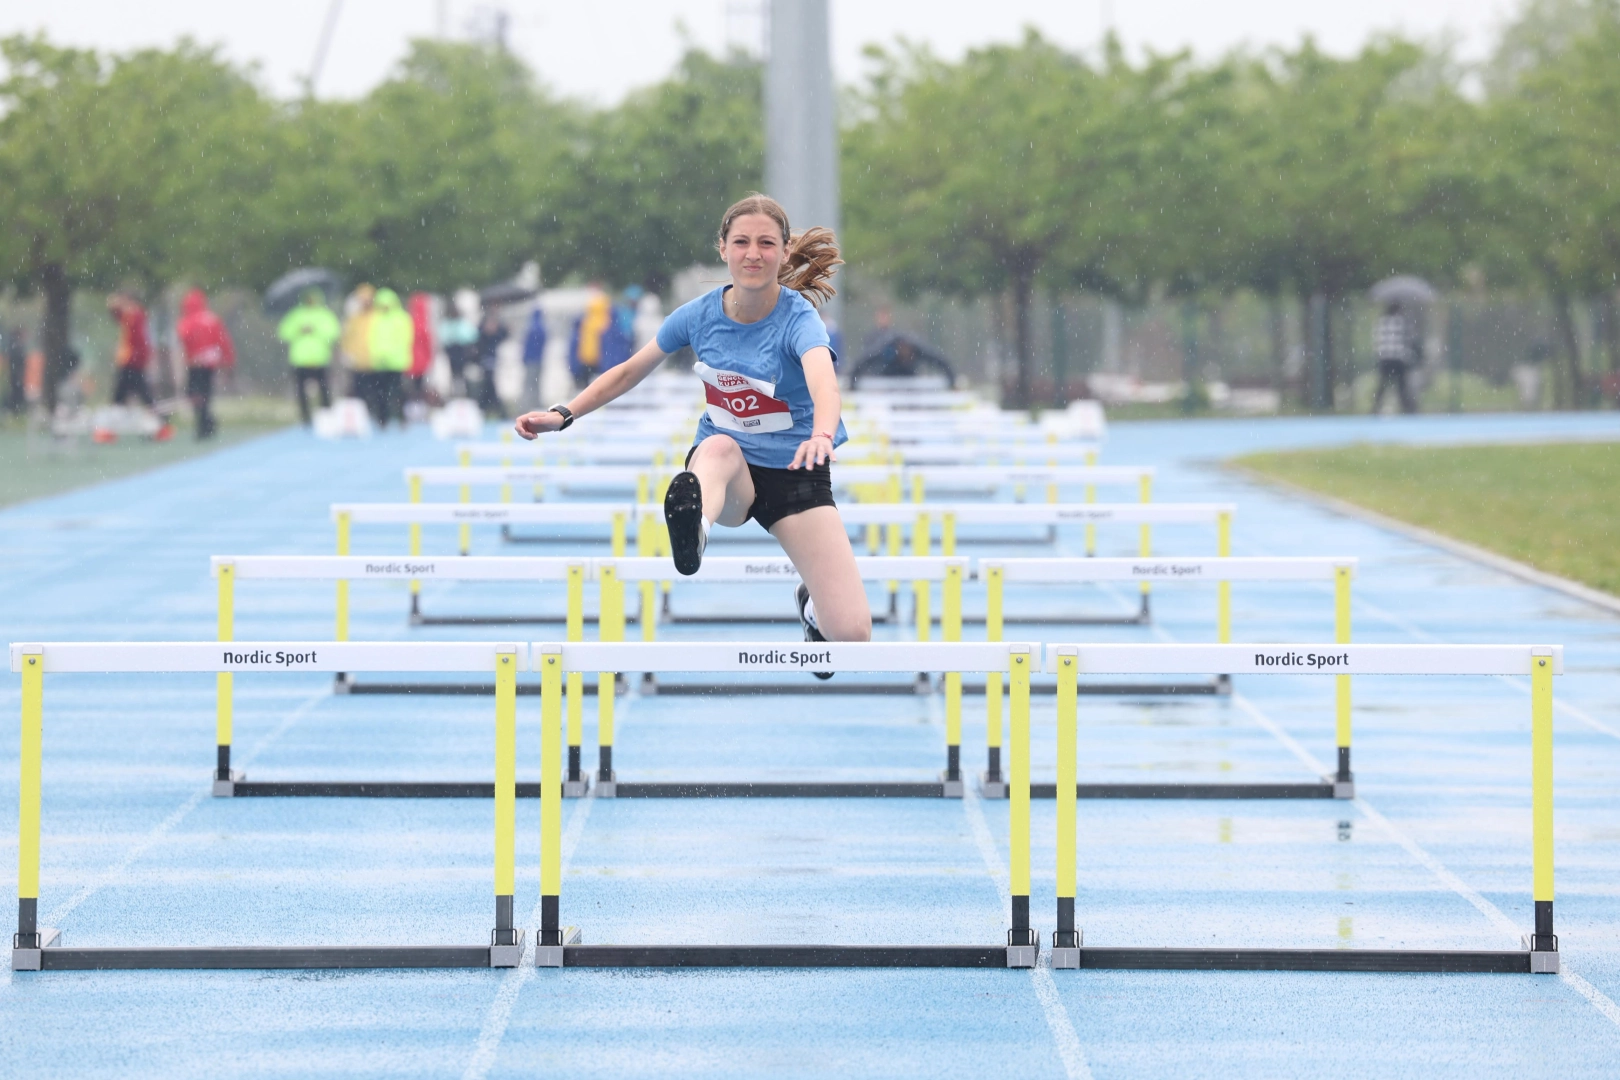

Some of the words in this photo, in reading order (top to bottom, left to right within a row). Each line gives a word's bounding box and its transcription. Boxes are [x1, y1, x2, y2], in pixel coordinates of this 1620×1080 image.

[723, 395, 759, 412] 102
[275, 650, 317, 667] Sport
[789, 650, 831, 667] Sport
[1306, 652, 1349, 669] Sport
